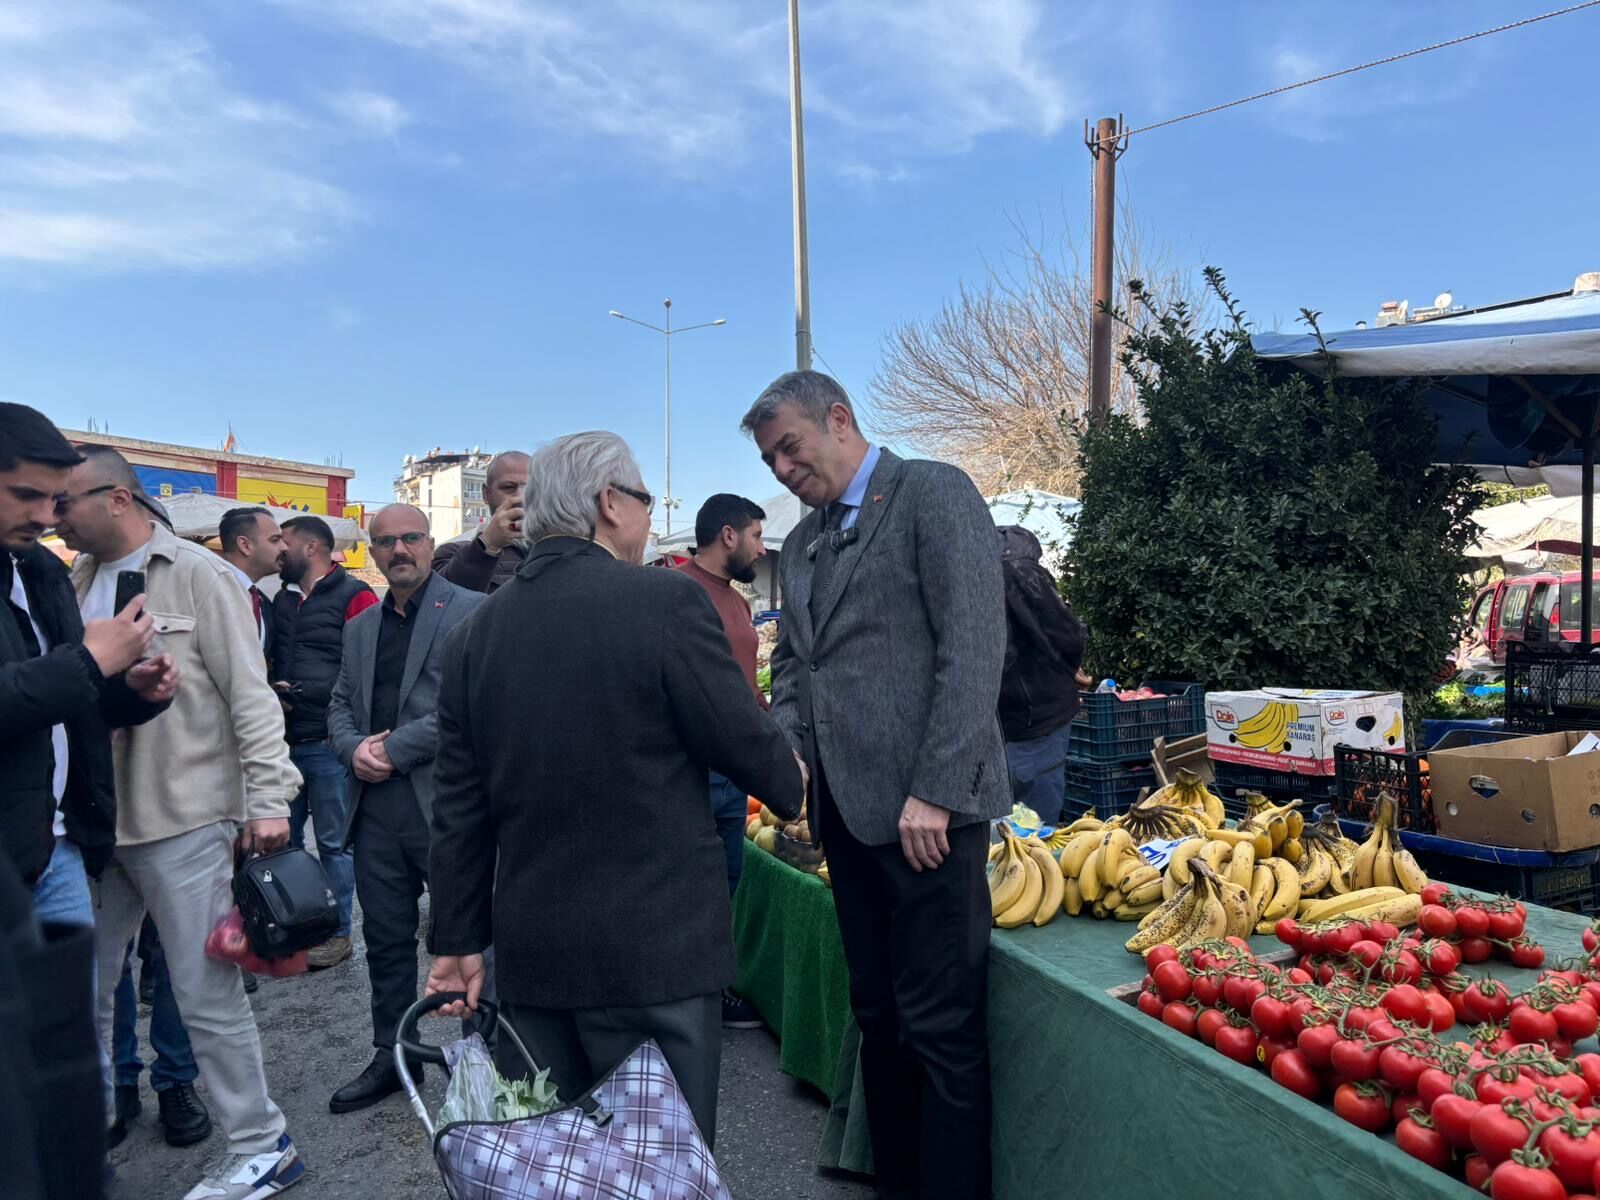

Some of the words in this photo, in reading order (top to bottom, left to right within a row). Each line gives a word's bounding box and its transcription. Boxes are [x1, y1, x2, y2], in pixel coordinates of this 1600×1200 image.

[1216, 710, 1235, 722] Dole
[1329, 710, 1345, 720] Dole
[1286, 722, 1315, 732] PREMIUM
